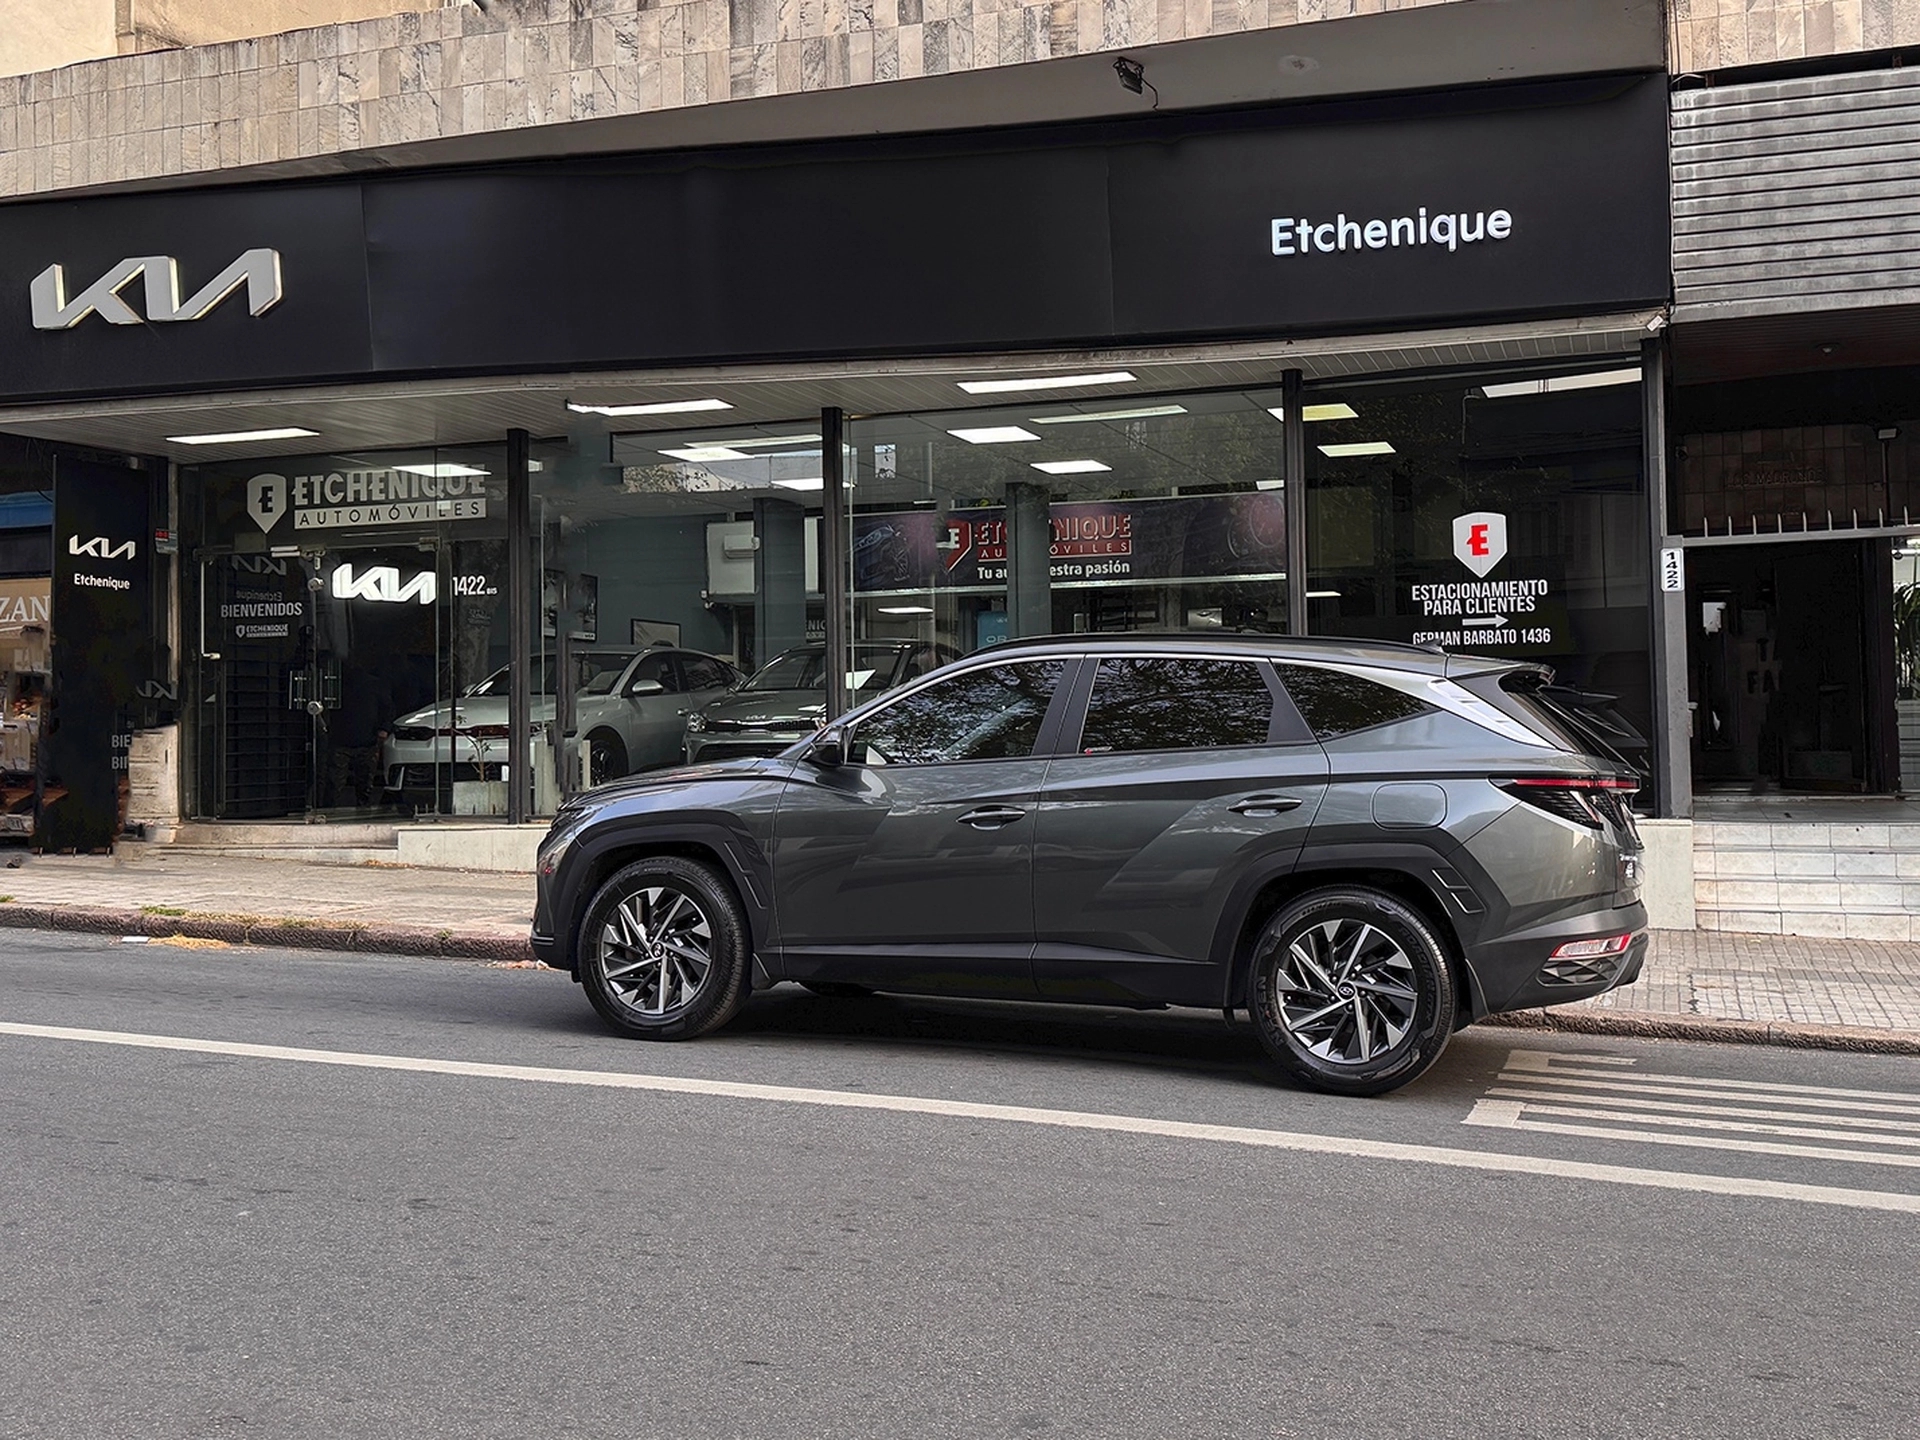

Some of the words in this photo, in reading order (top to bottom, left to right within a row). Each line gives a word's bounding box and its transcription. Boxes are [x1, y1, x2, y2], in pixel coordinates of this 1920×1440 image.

[1270, 206, 1512, 256] Etchenique
[30, 247, 283, 330] KIA
[292, 464, 486, 506] ETCHENIQUE
[299, 502, 480, 526] AUTOMÓVILES
[69, 535, 136, 560] KIA
[977, 567, 993, 579] Tu
[1085, 561, 1130, 578] pasión
[1666, 551, 1678, 588] 1422
[74, 573, 131, 591] Etchenique
[332, 562, 437, 605] KIA
[453, 575, 486, 596] 1422
[1411, 579, 1548, 601] ESTACIONAMIENTO
[221, 602, 303, 618] BIENVENIDOS
[1424, 599, 1462, 616] PARA
[1465, 596, 1536, 614] CLIENTES
[1464, 629, 1517, 645] BARBATO
[1521, 628, 1551, 644] 1436
